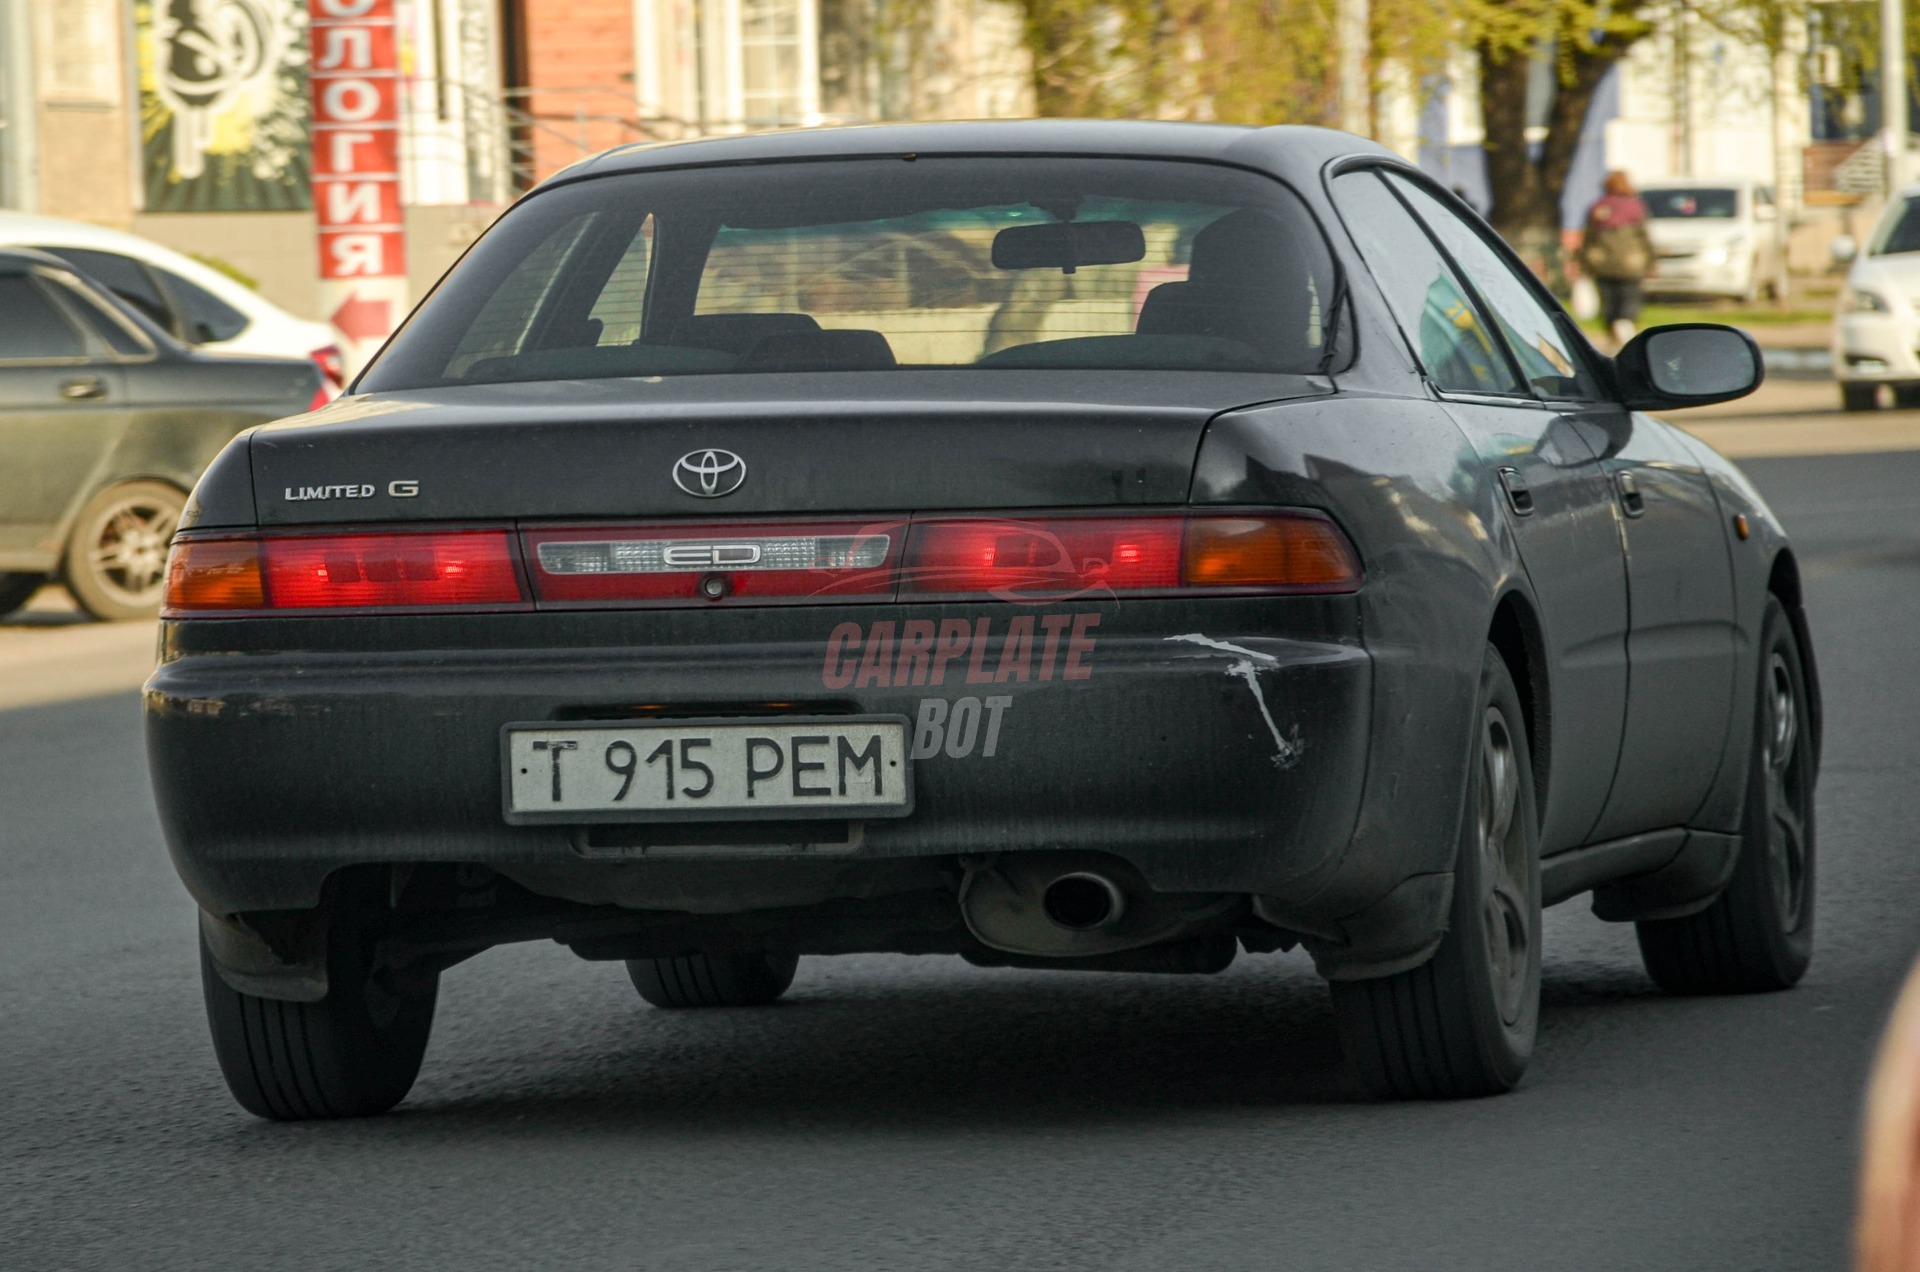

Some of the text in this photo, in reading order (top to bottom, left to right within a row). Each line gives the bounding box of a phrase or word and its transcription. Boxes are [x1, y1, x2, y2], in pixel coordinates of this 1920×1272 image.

[285, 480, 419, 501] LIMITED G
[663, 545, 761, 566] ED
[533, 735, 883, 802] T 915 PEM
